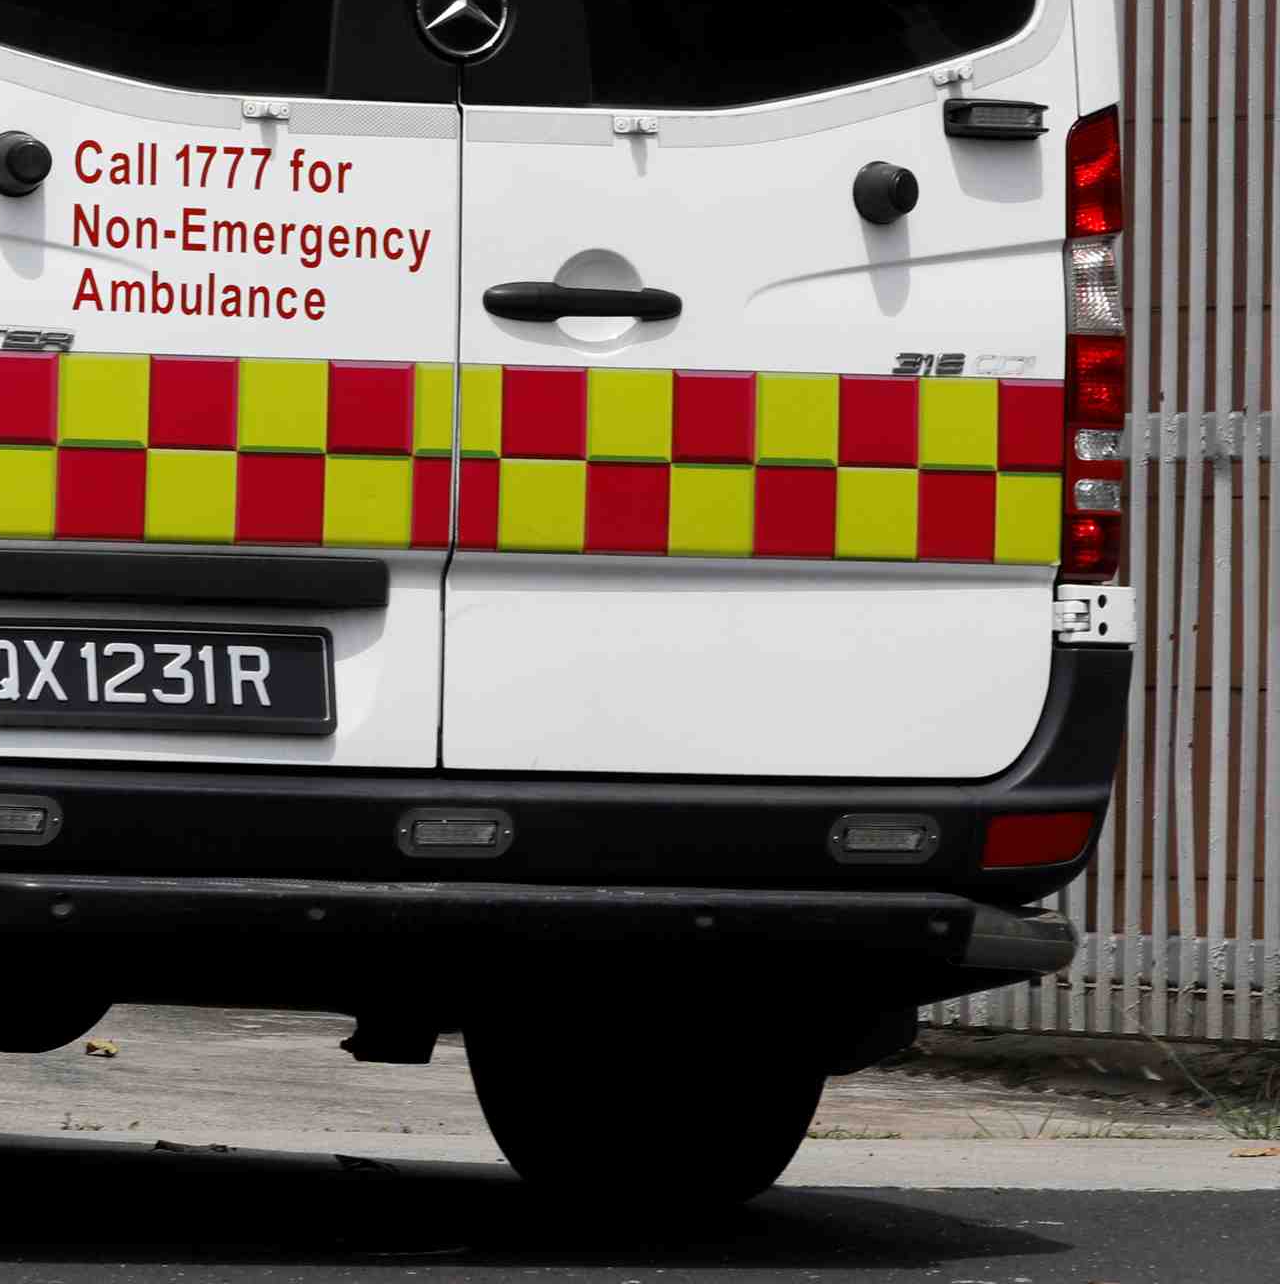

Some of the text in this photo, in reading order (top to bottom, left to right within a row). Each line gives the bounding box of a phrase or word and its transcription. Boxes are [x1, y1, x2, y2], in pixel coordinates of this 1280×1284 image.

[74, 139, 353, 194] Call 1777 for
[72, 203, 432, 273] Non-Emergency
[72, 267, 327, 322] Ambulance
